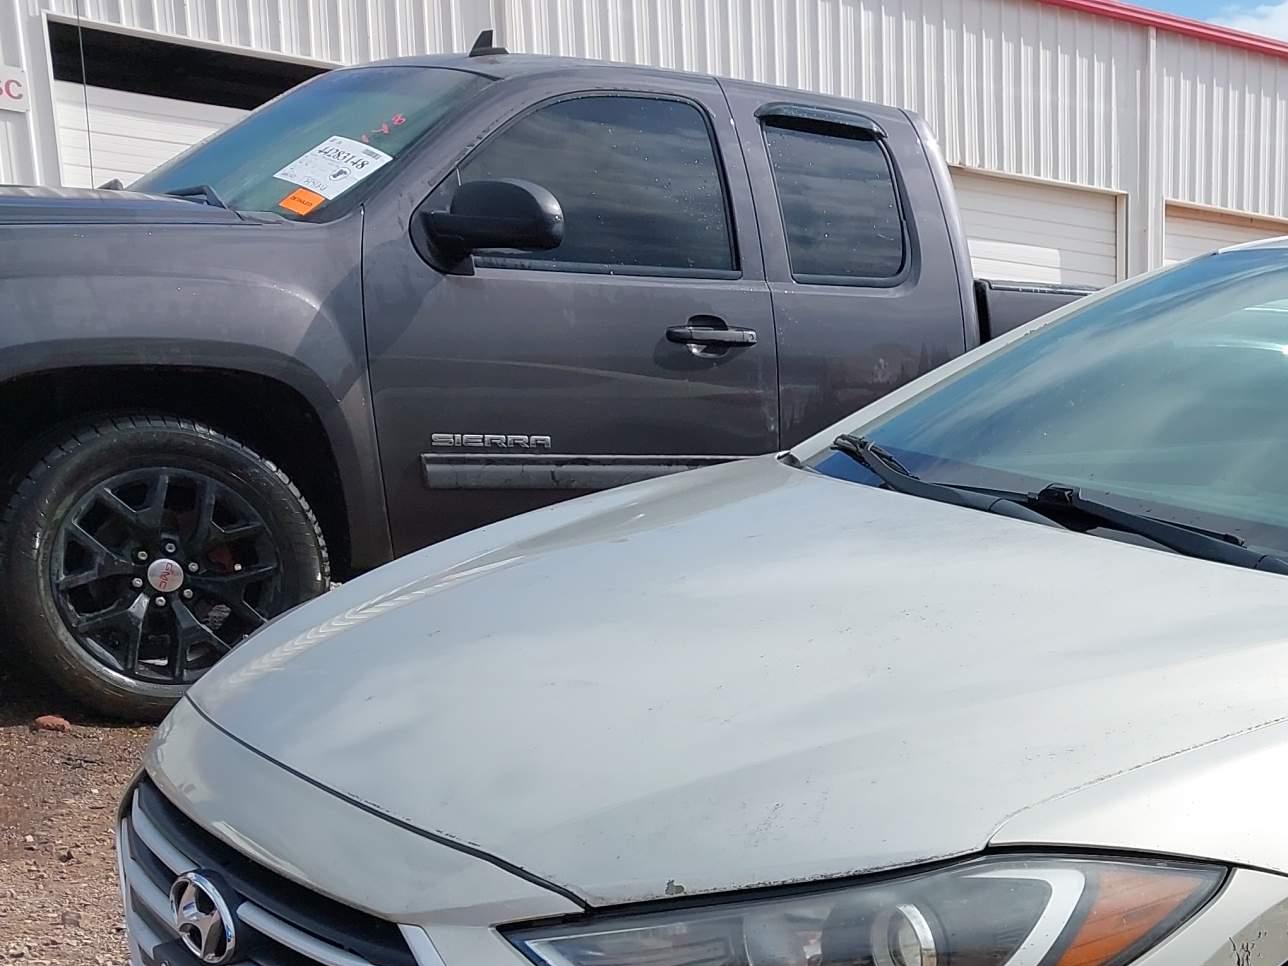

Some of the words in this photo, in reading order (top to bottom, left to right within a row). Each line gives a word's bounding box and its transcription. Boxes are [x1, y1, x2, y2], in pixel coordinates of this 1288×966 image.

[0, 79, 23, 100] C
[431, 433, 552, 448] SIERRA
[159, 561, 175, 589] GMC
